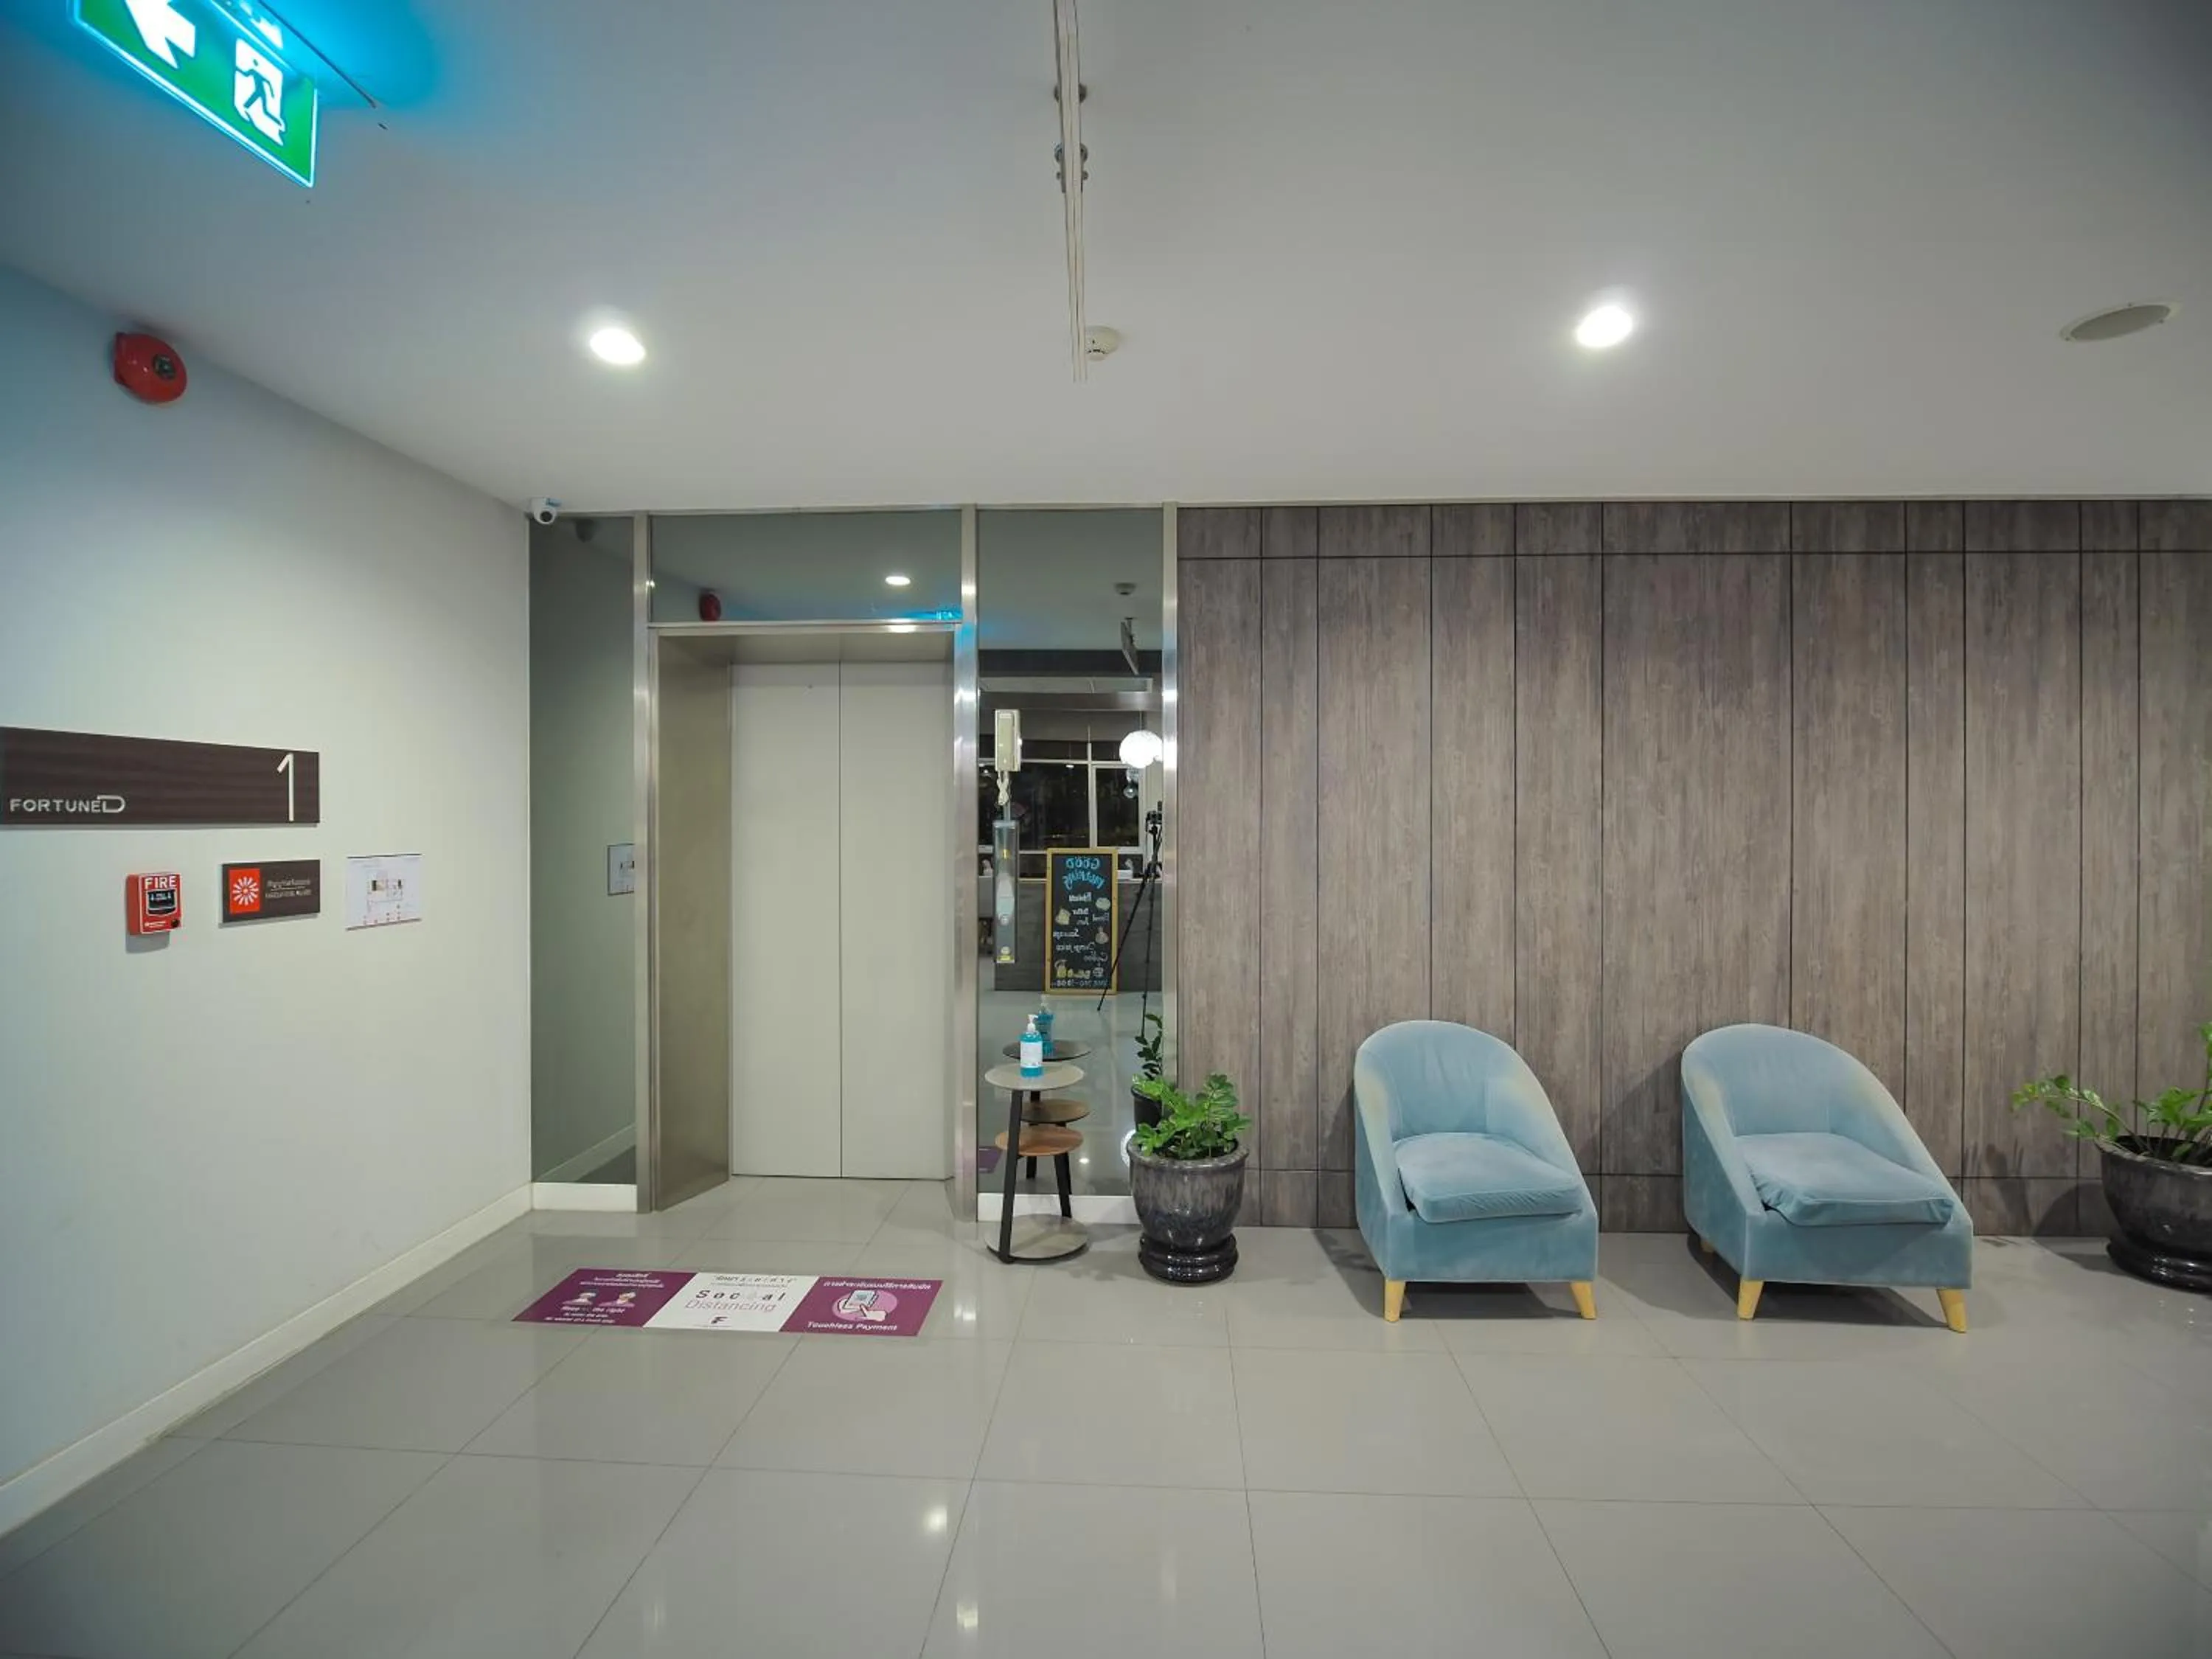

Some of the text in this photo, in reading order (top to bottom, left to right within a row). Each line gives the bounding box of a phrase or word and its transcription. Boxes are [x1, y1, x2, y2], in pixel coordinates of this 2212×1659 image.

[276, 752, 295, 822] 1
[145, 875, 177, 889] FIRE
[695, 1290, 786, 1301] Socal
[685, 1299, 777, 1312] Distancing
